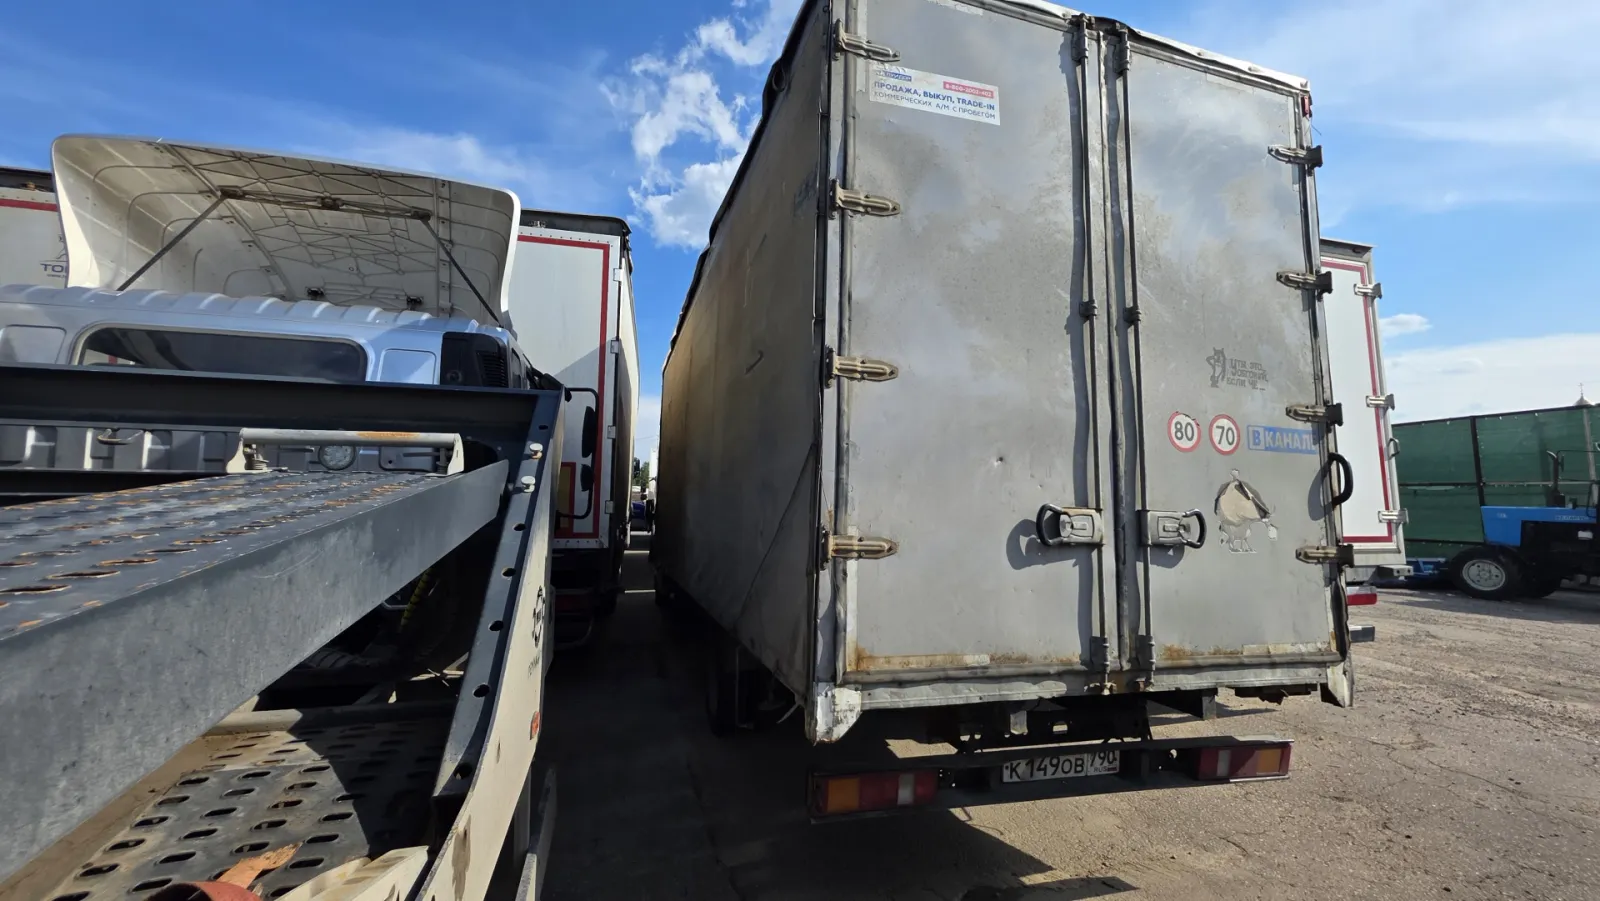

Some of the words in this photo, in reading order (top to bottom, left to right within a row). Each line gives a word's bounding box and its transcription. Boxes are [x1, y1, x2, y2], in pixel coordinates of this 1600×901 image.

[874, 81, 921, 97] ПРОДАЖА,
[923, 91, 955, 104] ВЫКУП,
[957, 97, 995, 111] TRADE-IN
[874, 91, 932, 107] КОММЕРЧЕСКИХ
[936, 103, 950, 111] А/М
[959, 107, 996, 120] ПРОБЕГОМ
[1226, 377, 1246, 387] ЕСЛИ
[1174, 421, 1195, 442] 80
[1215, 425, 1235, 446] 70
[1252, 430, 1261, 446] В
